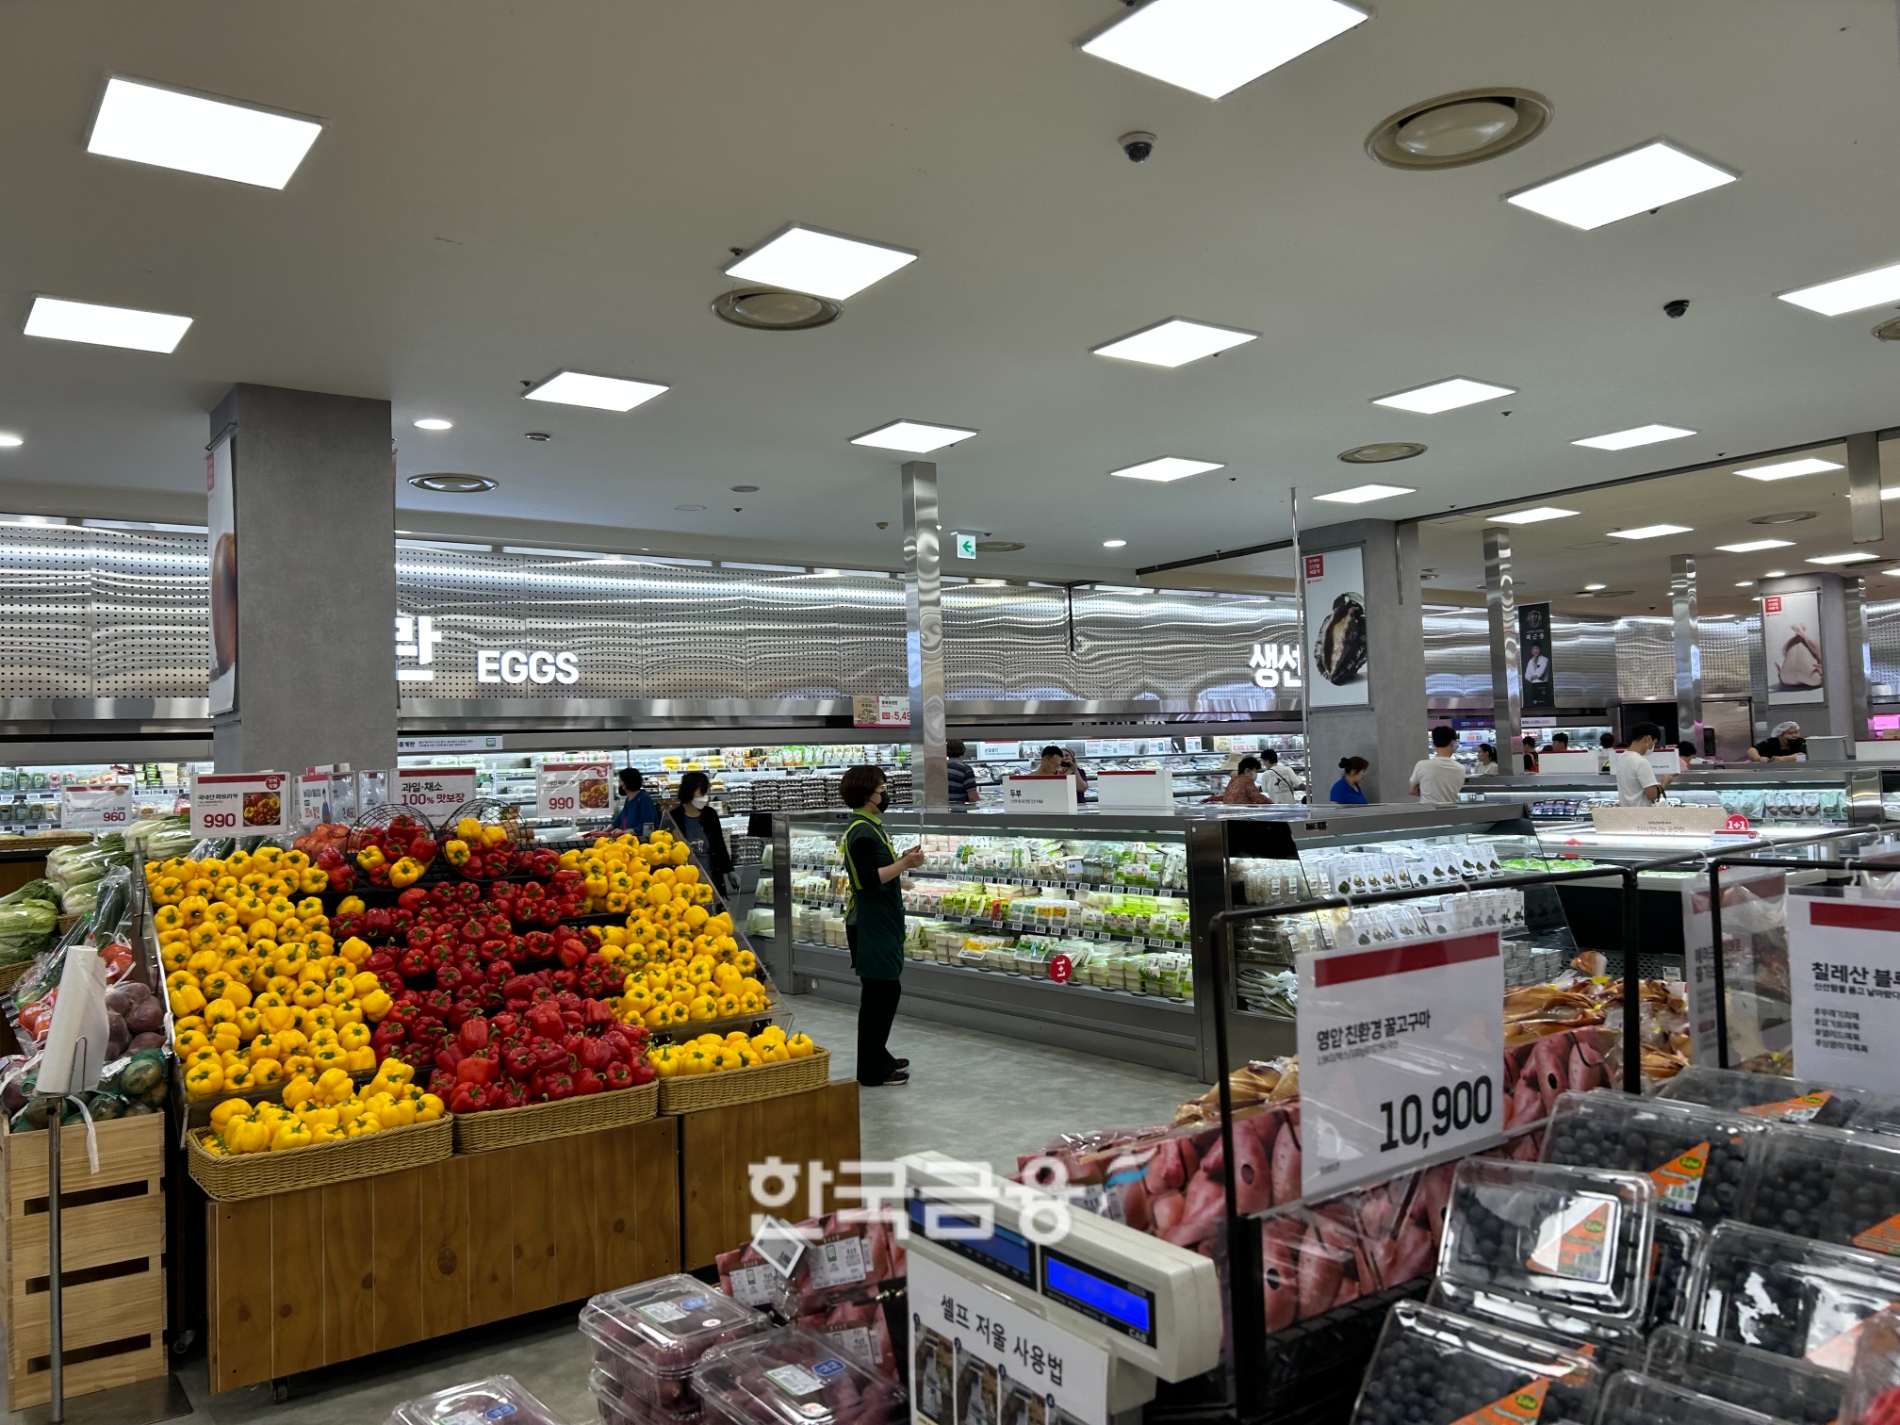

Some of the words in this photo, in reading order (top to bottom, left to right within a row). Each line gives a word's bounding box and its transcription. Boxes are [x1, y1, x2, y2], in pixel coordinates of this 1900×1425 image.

[477, 650, 580, 684] EGGS
[1249, 643, 1302, 688] 생선
[401, 781, 443, 793] 과일·채소
[1010, 789, 1022, 798] 두부
[401, 793, 435, 806] 100%
[436, 793, 465, 804] 맛보장
[548, 796, 575, 810] 990
[103, 811, 126, 822] 960
[203, 812, 236, 829] 990
[1728, 820, 1746, 830] 1+1
[1056, 959, 1066, 977] 1+1
[1811, 962, 1869, 985] 칠레산
[1316, 1027, 1344, 1052] 영암
[1345, 1018, 1382, 1045] 친환경
[1384, 1008, 1432, 1038] 꿀고구마
[1379, 1075, 1492, 1153] 10,900
[941, 1294, 970, 1330] 셀프
[975, 1313, 1007, 1353] 저울
[1013, 1335, 1063, 1388] 사용법
